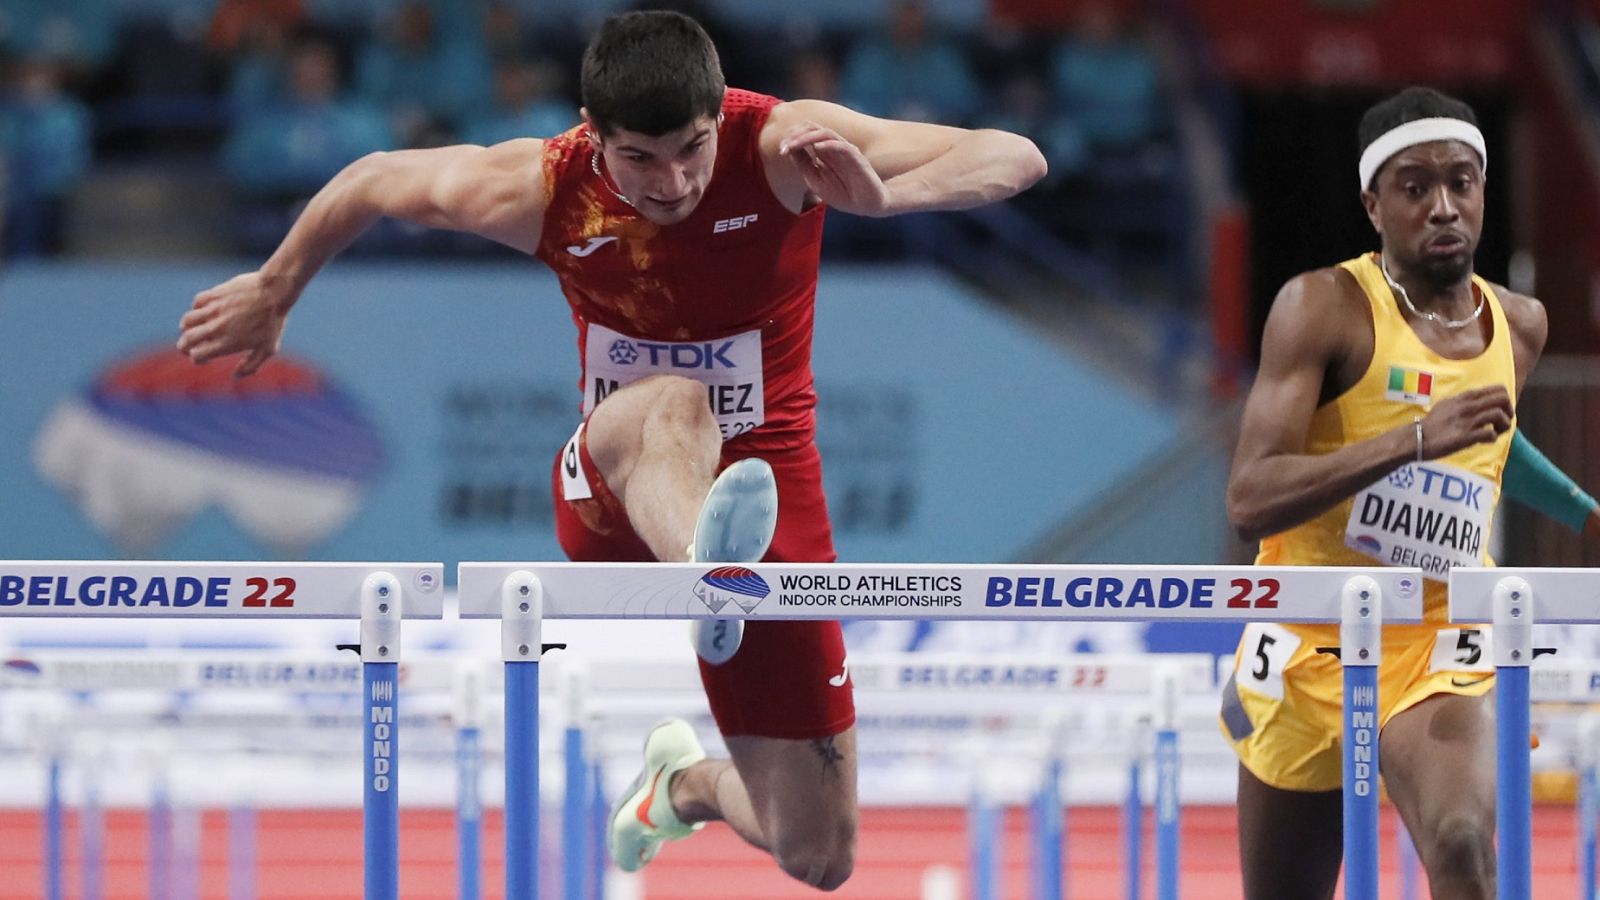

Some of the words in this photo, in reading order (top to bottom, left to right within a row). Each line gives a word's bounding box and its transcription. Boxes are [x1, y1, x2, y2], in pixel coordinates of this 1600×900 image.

[713, 213, 758, 233] ESP
[637, 341, 736, 369] TDK
[1417, 466, 1482, 511] TDK
[1360, 493, 1481, 558] DIAWARA
[1391, 545, 1472, 574] BELGRA
[0, 575, 231, 607] BELGRADE
[242, 577, 297, 607] 22
[779, 594, 836, 606] INDOOR
[840, 594, 962, 607] CHAMPIONSHIPS
[780, 575, 850, 591] WORLD
[857, 575, 962, 591] ATHLETICS
[985, 576, 1216, 608] BELGRADE
[1227, 578, 1281, 608] 22
[1252, 633, 1276, 680] 5
[1454, 629, 1481, 665] 5
[371, 706, 392, 792] MONDO
[1353, 711, 1373, 796] MONDO
